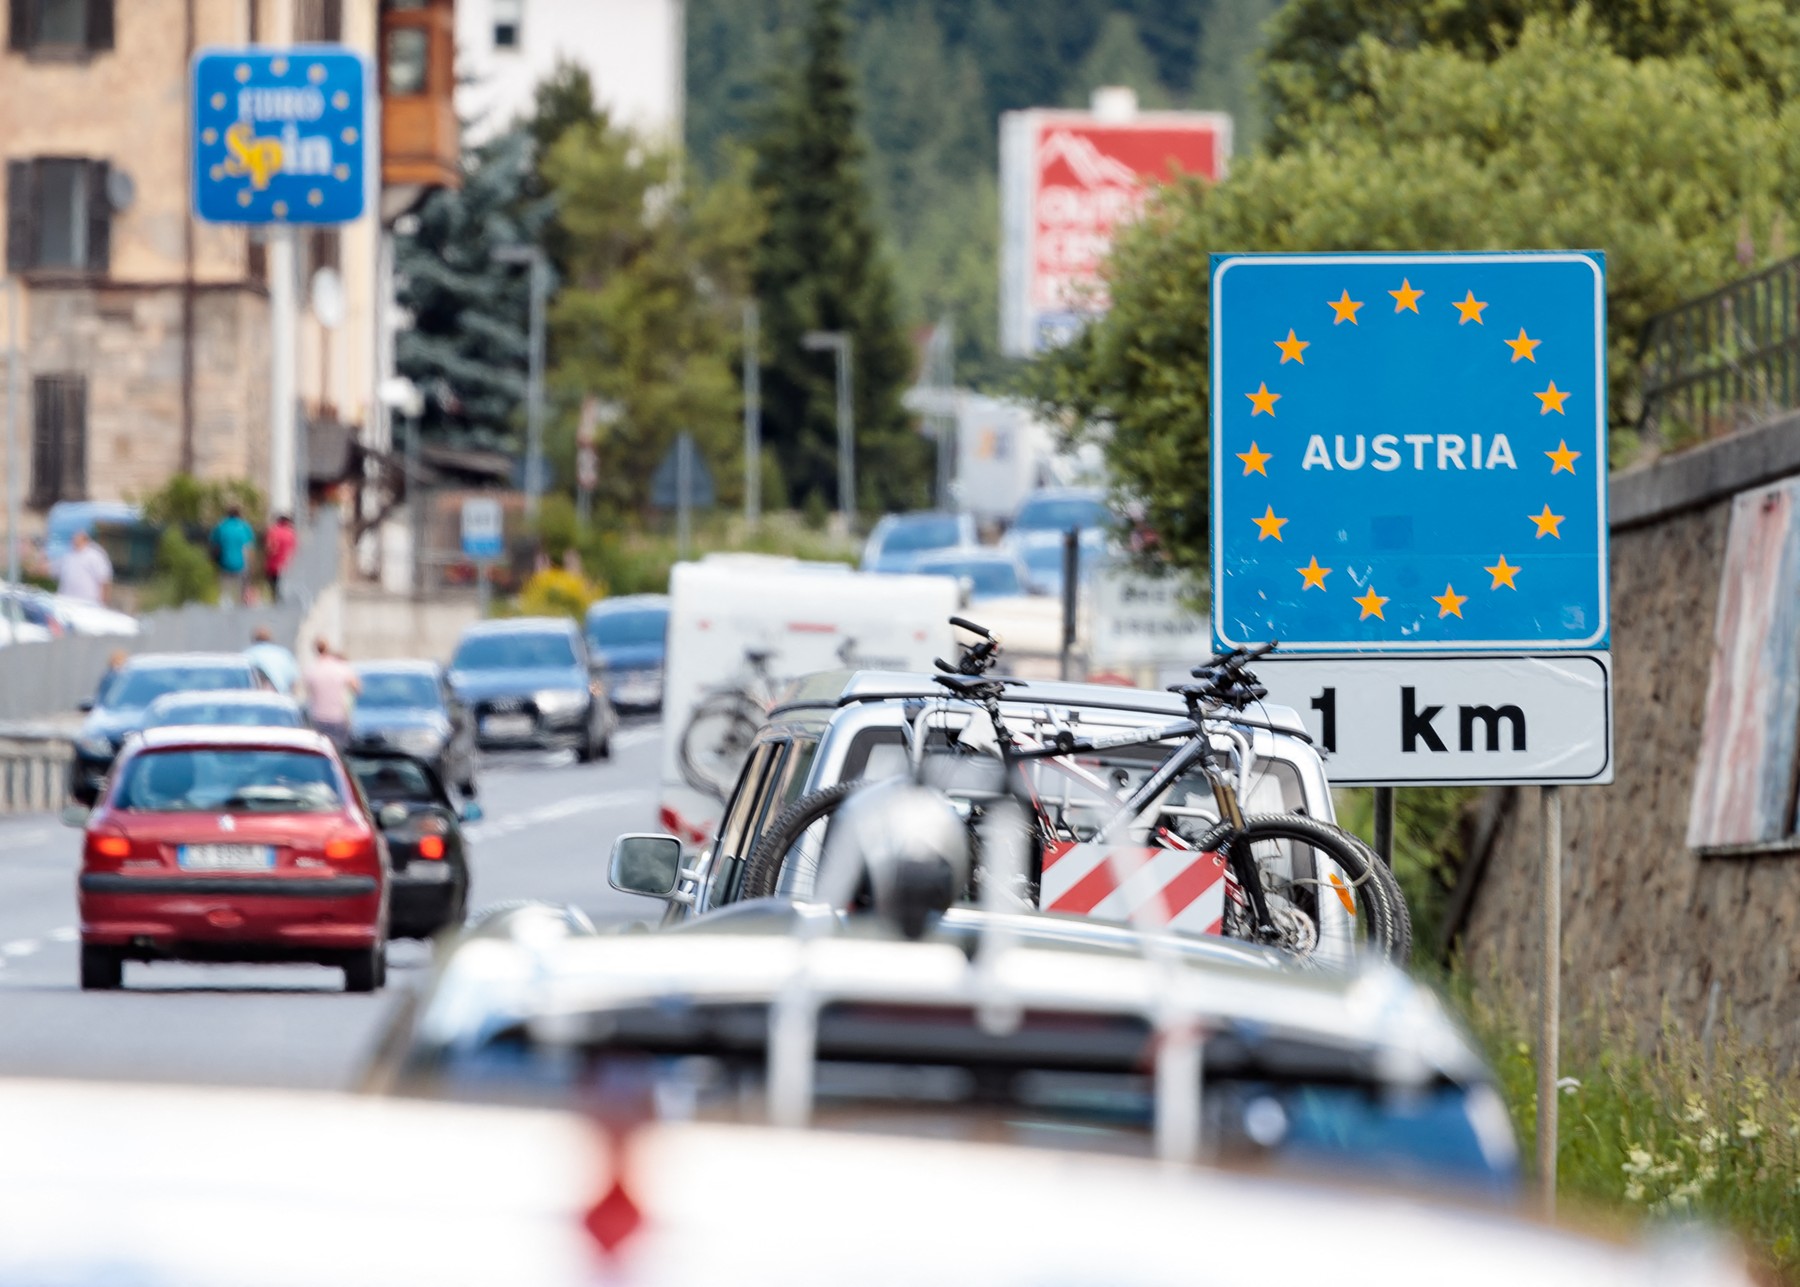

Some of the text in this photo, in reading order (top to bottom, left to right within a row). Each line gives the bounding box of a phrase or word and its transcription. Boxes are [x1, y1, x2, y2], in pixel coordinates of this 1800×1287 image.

[224, 121, 332, 190] Spin
[1302, 433, 1518, 472] AUSTRIA
[1310, 685, 1528, 753] 1 km
